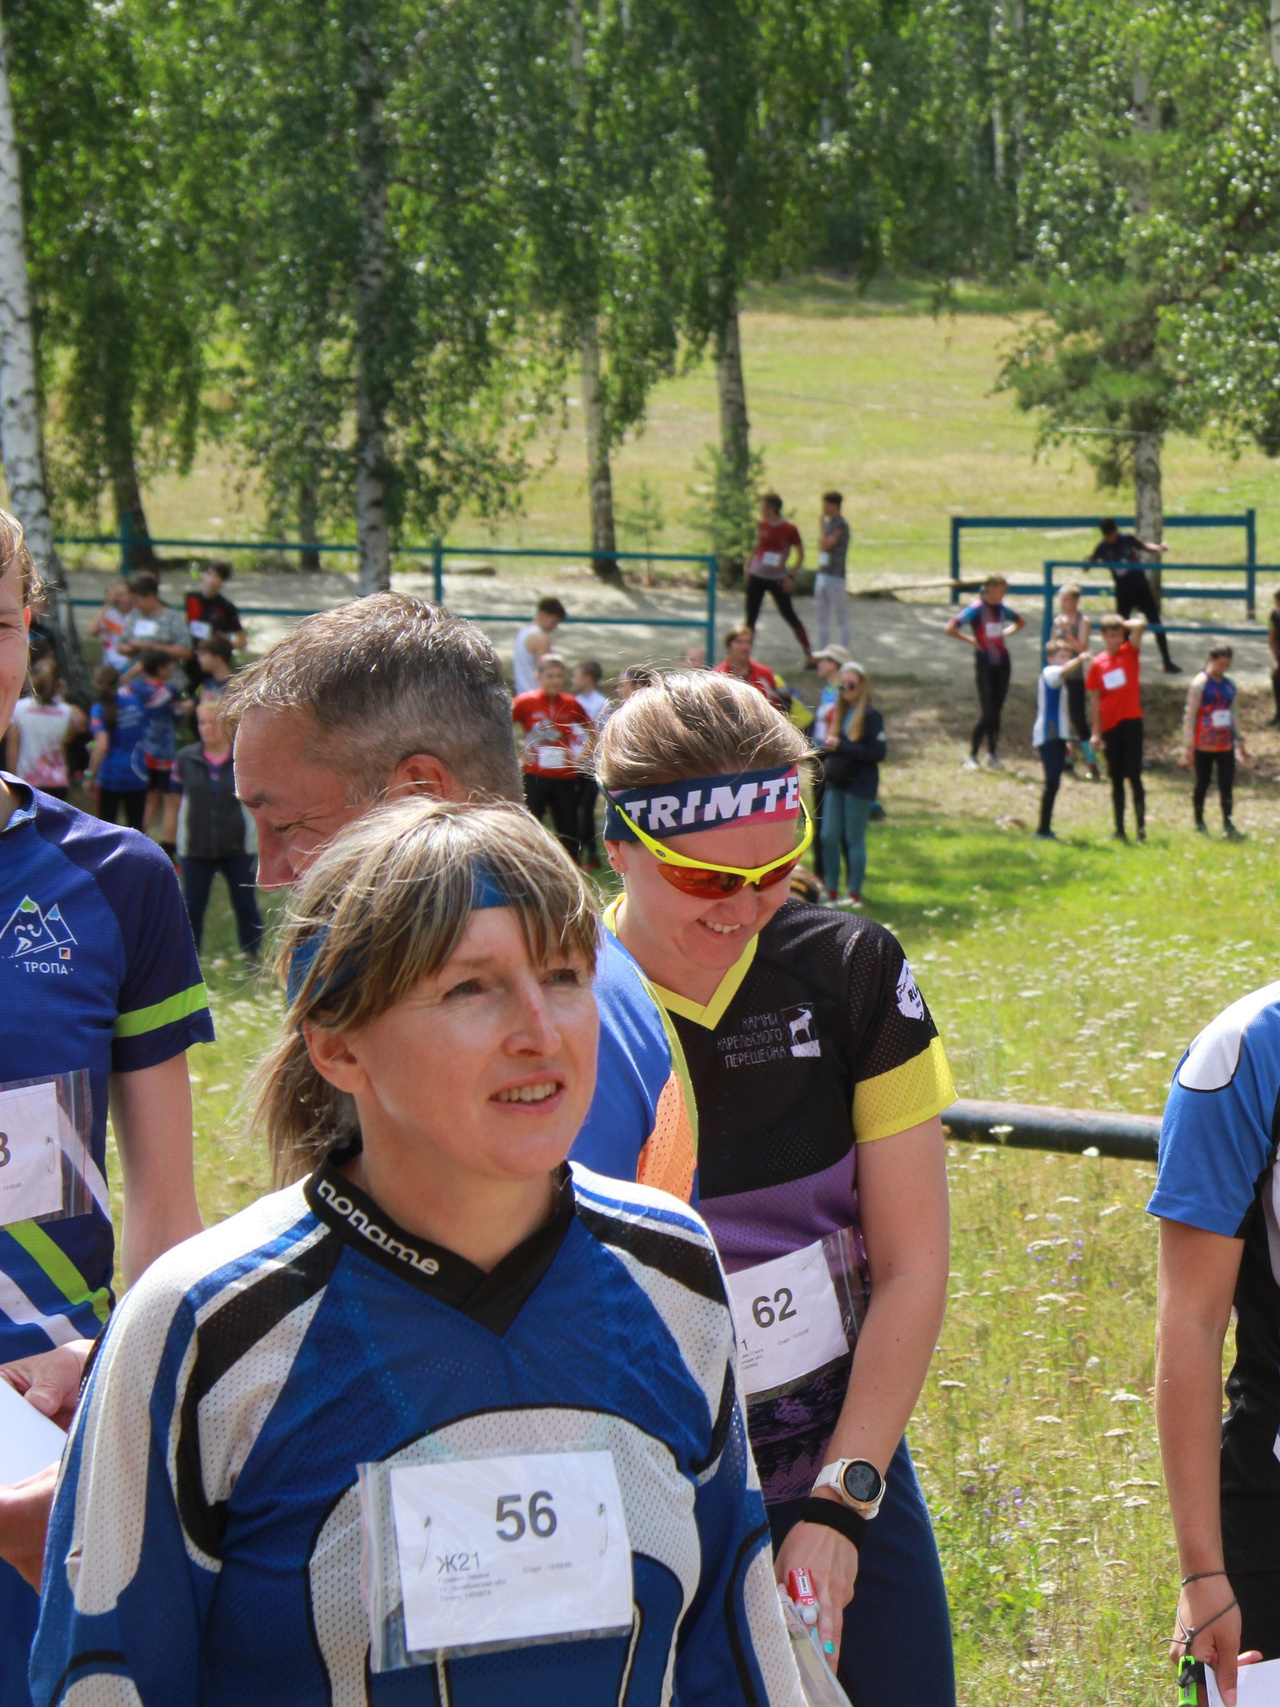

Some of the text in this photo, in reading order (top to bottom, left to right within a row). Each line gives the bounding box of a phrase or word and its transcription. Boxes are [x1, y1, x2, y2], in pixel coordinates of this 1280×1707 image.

[23, 961, 68, 975] ТРОПА
[742, 1012, 779, 1030] КАМНИ
[724, 1045, 787, 1068] ПЕРЕШЕЙКА
[317, 1179, 440, 1275] noname
[752, 1287, 797, 1329] 62
[496, 1490, 558, 1542] 56
[436, 1551, 480, 1574] Ж21
